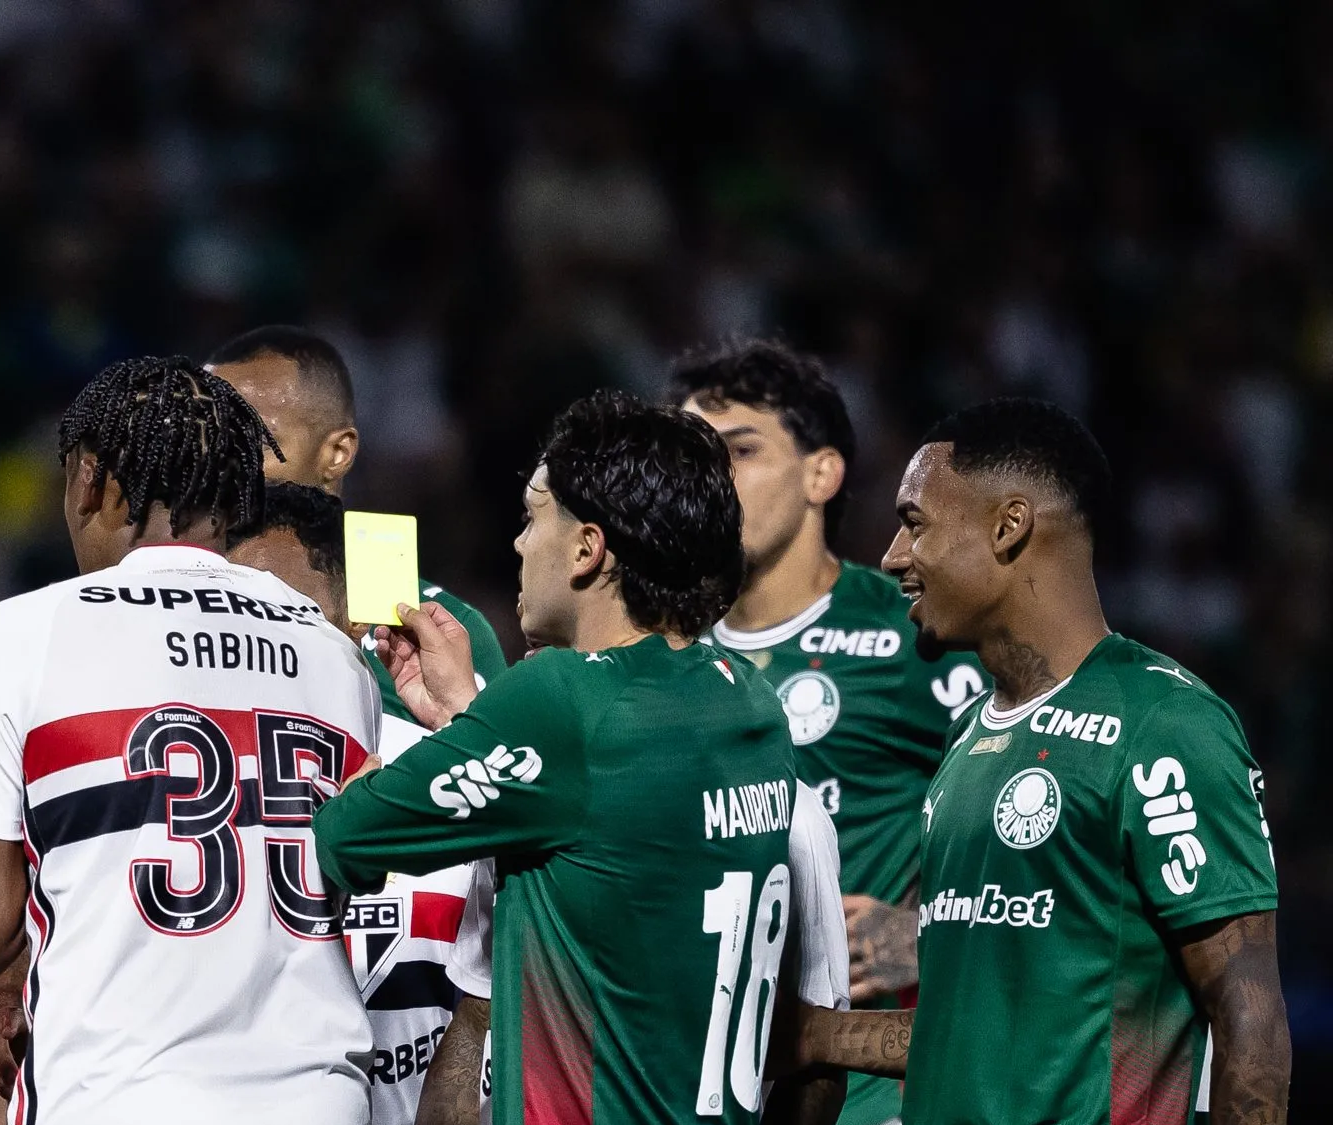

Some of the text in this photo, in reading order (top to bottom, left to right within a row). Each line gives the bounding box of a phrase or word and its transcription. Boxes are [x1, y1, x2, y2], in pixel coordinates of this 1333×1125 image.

[166, 631, 299, 679] SABINO
[800, 627, 901, 658] CIMED
[1029, 705, 1122, 746] CIMED
[124, 702, 347, 941] 35
[703, 779, 790, 839] MAURICIO
[998, 801, 1056, 844] PALMEIRAS
[695, 863, 790, 1116] 18
